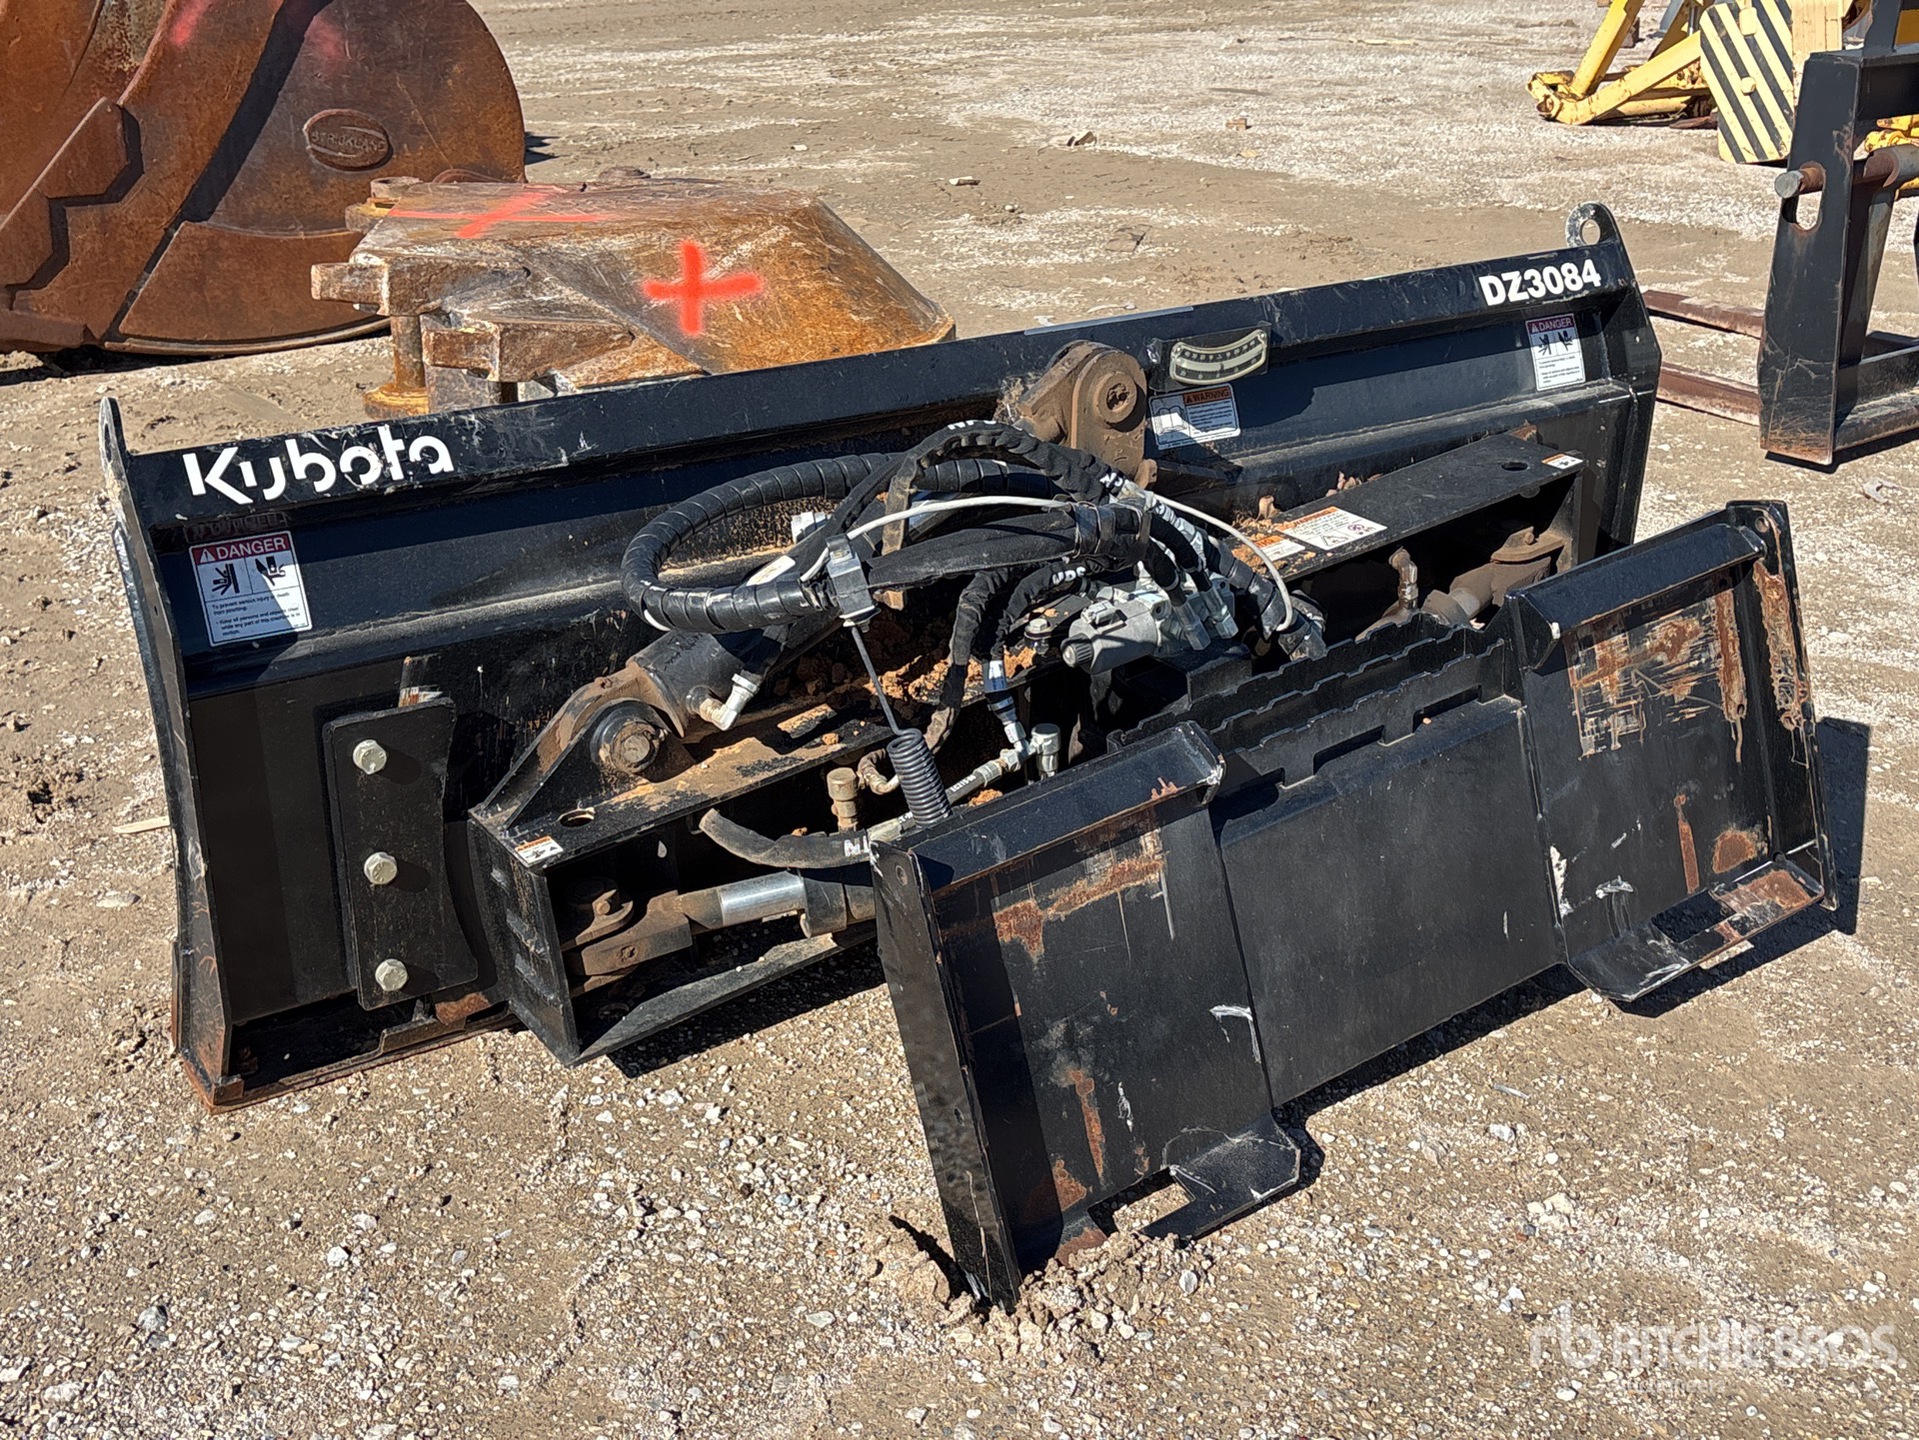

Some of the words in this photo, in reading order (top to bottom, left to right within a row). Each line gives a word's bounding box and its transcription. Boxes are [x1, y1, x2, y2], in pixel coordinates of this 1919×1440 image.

[1479, 259, 1602, 306] DZ3084
[1538, 317, 1573, 331] DANGER
[1195, 389, 1231, 402] WARNING
[182, 424, 454, 505] Kubota
[216, 537, 286, 560] DANGER
